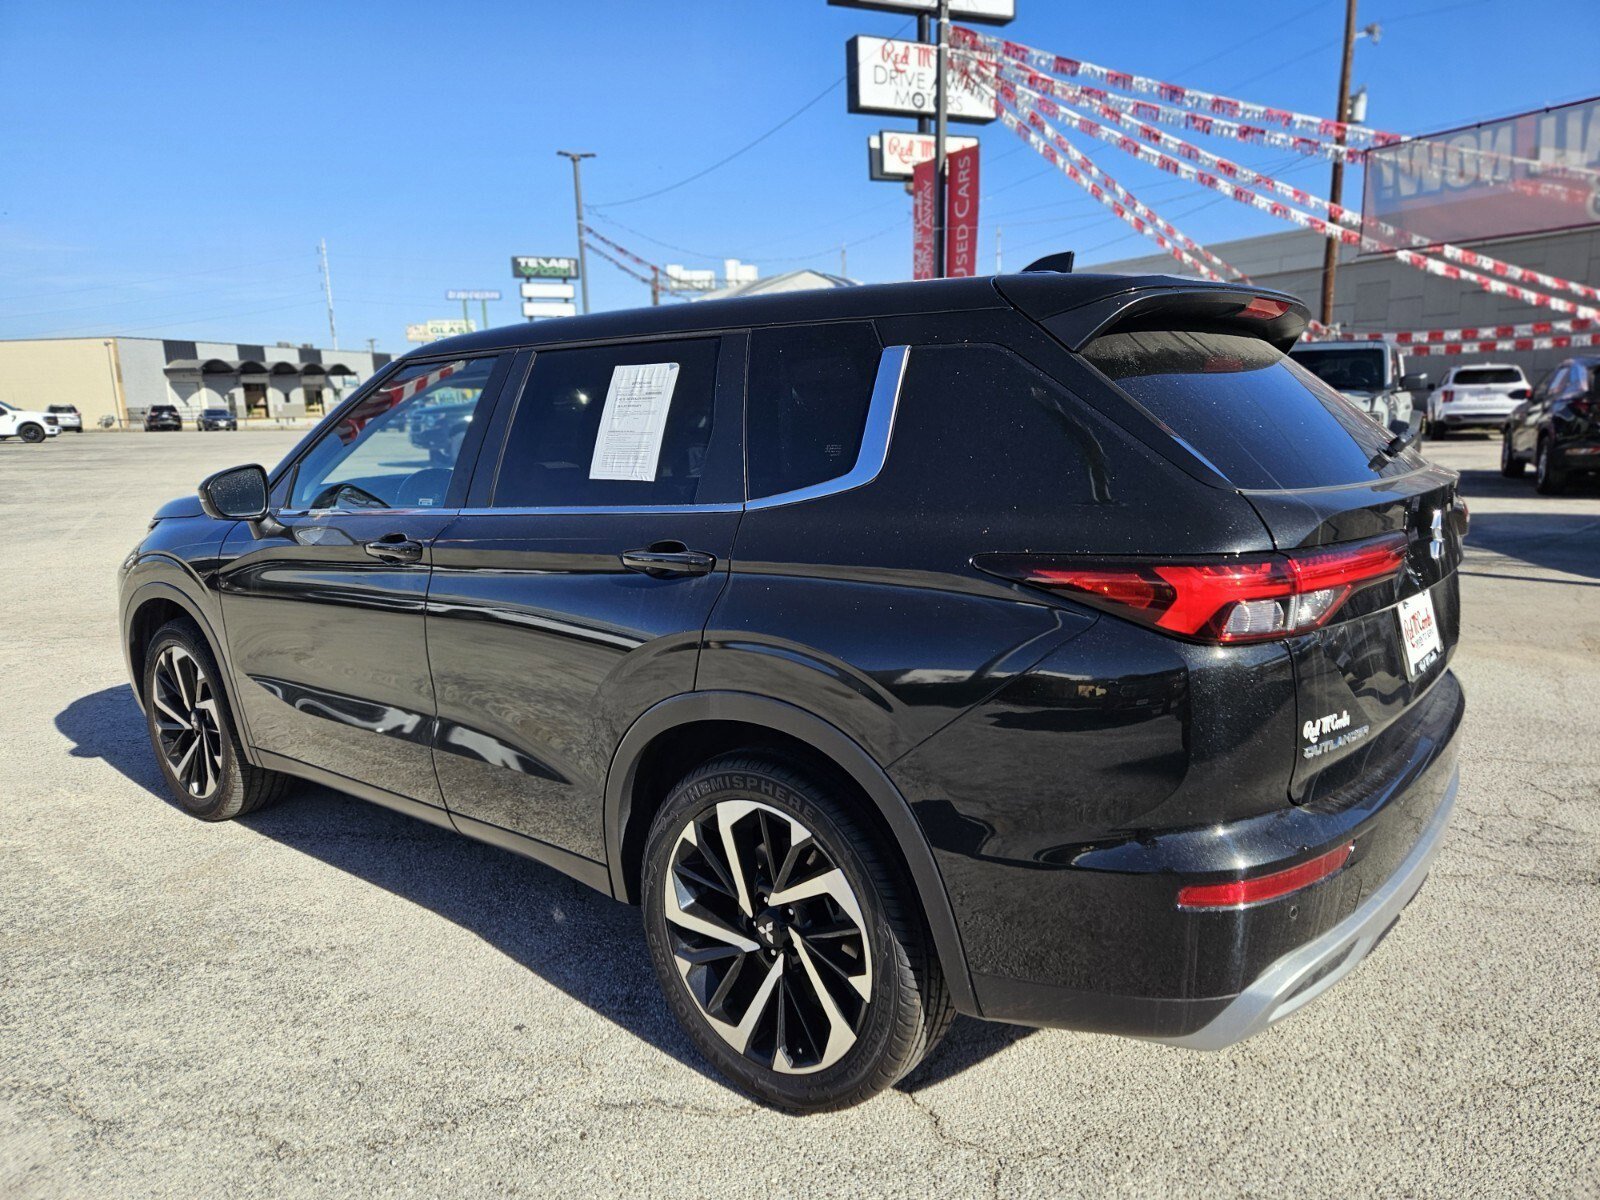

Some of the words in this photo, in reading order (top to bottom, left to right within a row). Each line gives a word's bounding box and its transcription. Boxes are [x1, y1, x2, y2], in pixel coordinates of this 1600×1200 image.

[882, 40, 909, 73] Red
[874, 65, 926, 90] DRIVE
[895, 89, 963, 112] MOTRS
[954, 156, 972, 219] CARS
[922, 179, 933, 230] AWAY
[517, 257, 569, 269] TEXAS
[686, 774, 817, 822] HEMISPHERE
